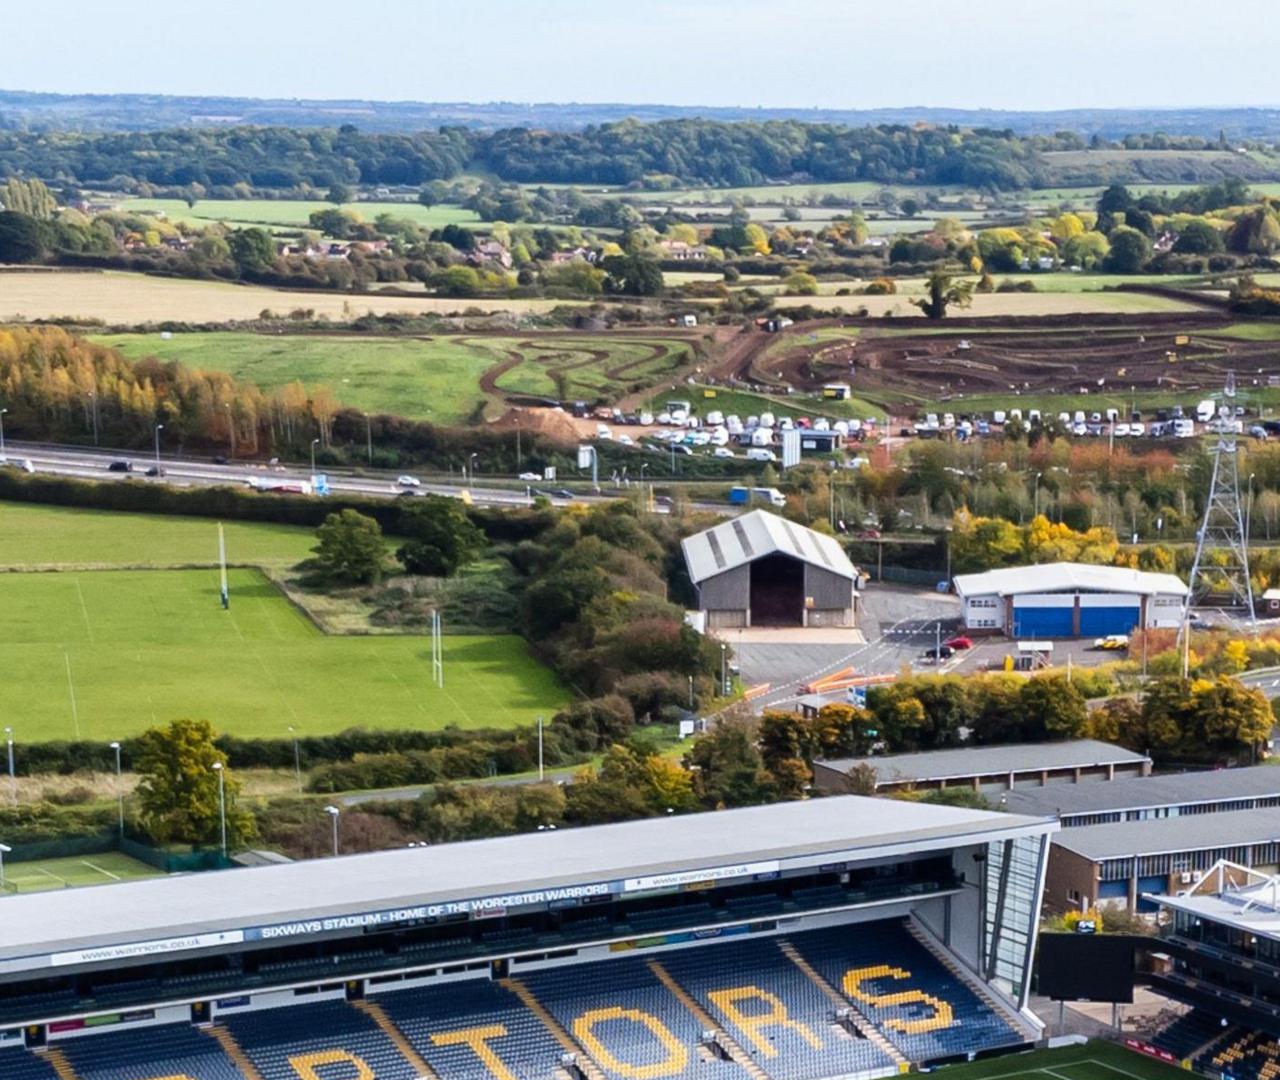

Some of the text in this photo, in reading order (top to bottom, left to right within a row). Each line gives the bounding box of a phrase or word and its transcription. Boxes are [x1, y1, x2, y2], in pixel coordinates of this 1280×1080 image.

[262, 922, 321, 938] SIXWAYS
[323, 914, 381, 931] STADIUM
[389, 907, 426, 921] HOME
[428, 905, 445, 917] OF
[446, 901, 470, 914] THE
[471, 891, 544, 910] WORCESTER
[546, 883, 609, 901] WARRIORS
